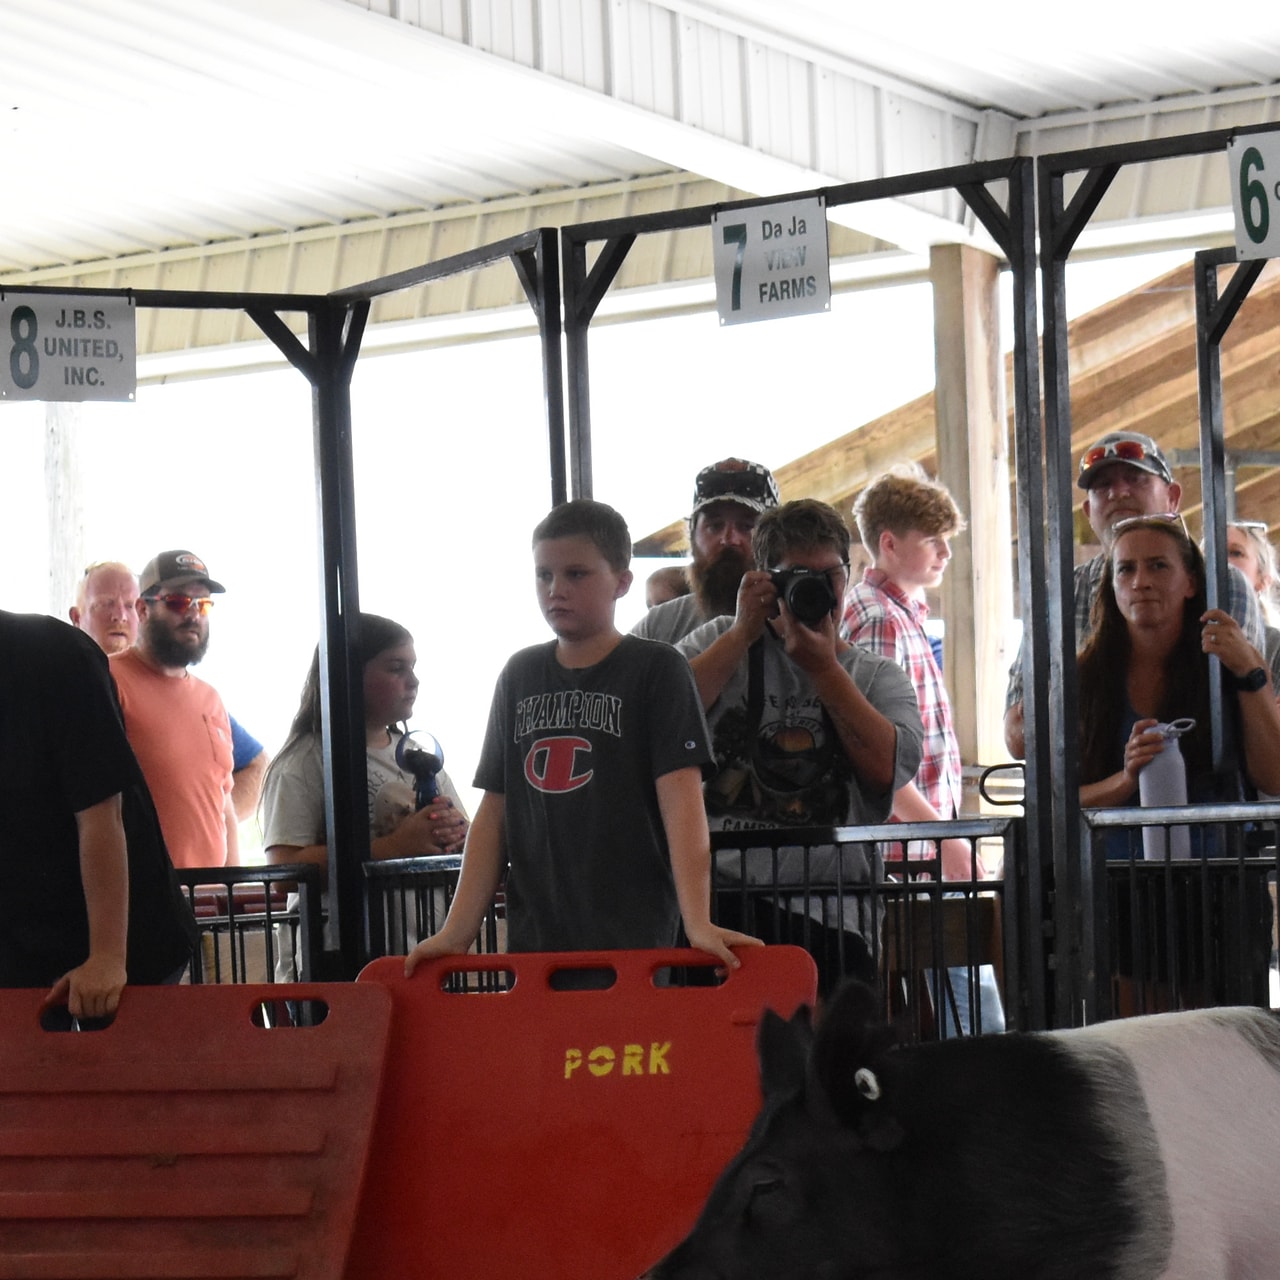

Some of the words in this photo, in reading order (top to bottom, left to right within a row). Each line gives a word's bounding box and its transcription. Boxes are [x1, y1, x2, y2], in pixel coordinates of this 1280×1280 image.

[1240, 147, 1269, 244] 6
[762, 220, 782, 241] Da
[788, 216, 807, 236] Ja
[723, 223, 747, 311] 7
[765, 246, 806, 271] VIEW
[759, 276, 817, 304] FARMS
[55, 309, 111, 329] J.B.S.
[10, 305, 39, 389] 8
[43, 337, 124, 362] UNITED,
[64, 366, 105, 387] INC.
[514, 690, 622, 744] CHAMPION
[564, 1041, 671, 1079] PORK
